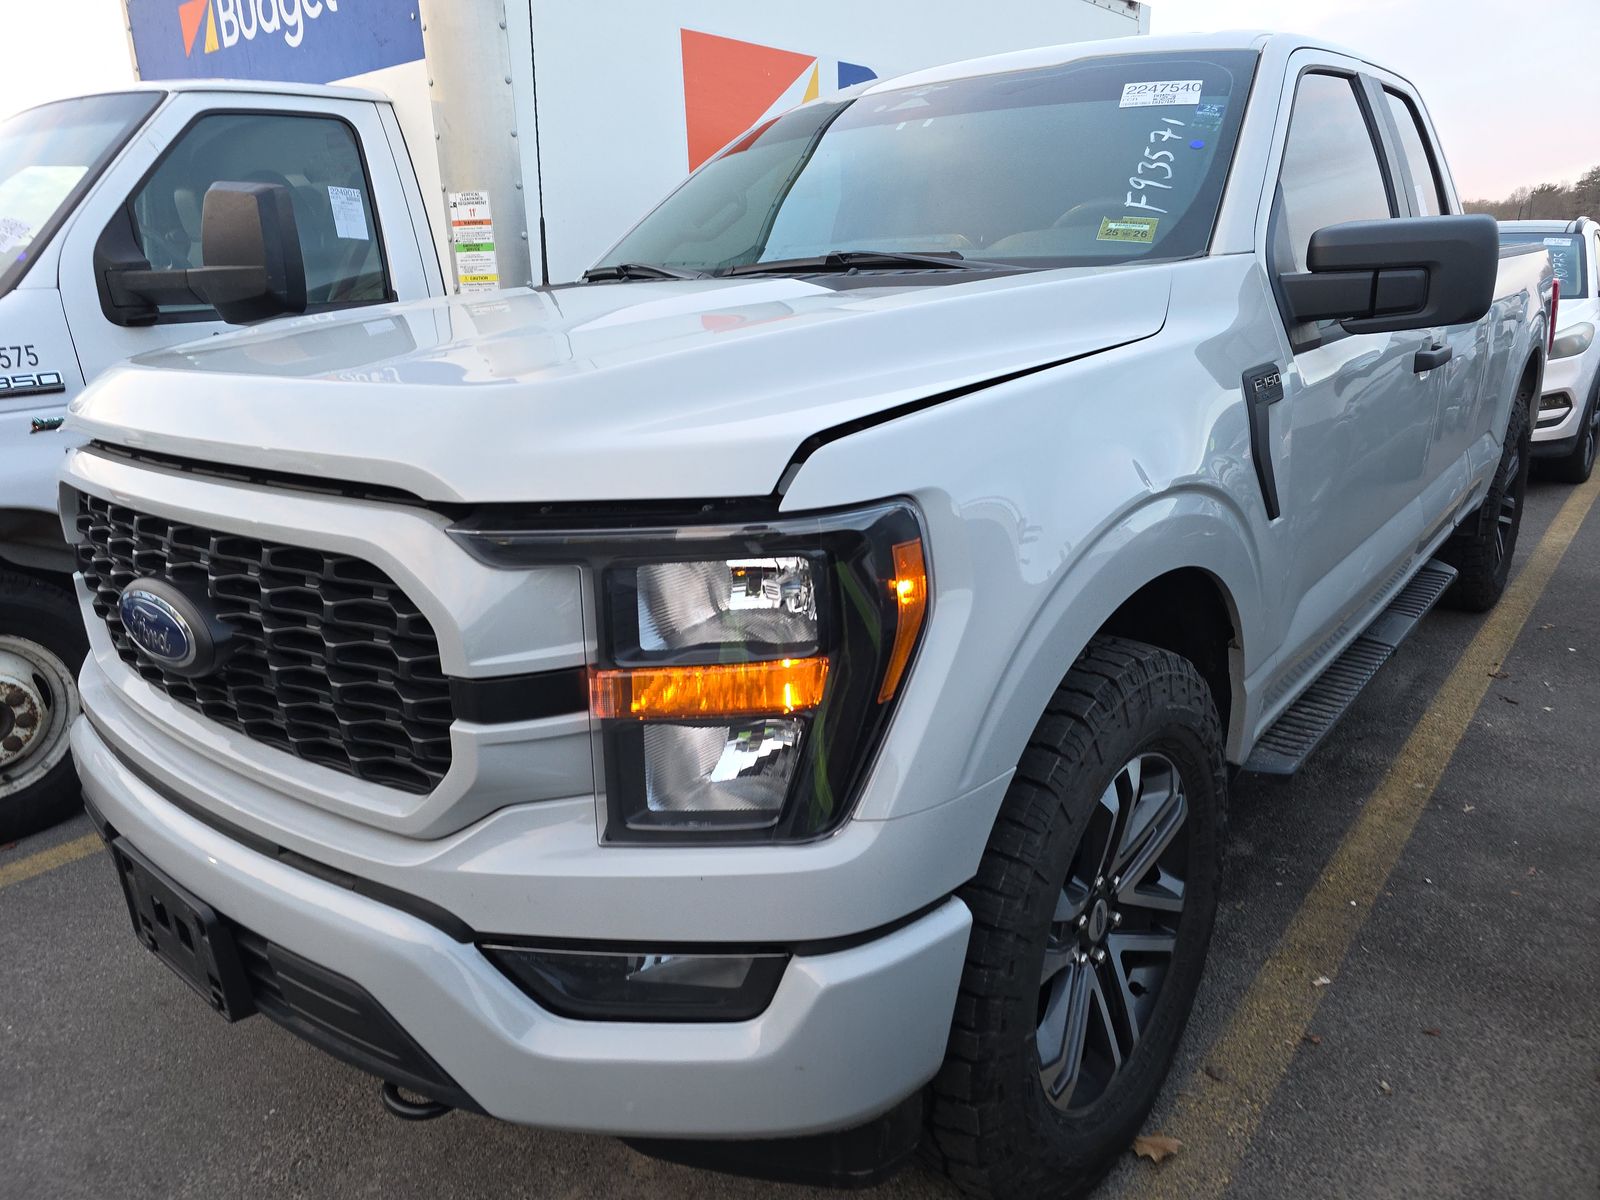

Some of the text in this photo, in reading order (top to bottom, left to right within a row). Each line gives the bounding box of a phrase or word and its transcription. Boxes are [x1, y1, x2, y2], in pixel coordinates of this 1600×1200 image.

[217, 0, 338, 48] Budg
[1126, 82, 1202, 95] 2247540
[1203, 105, 1218, 113] 25
[1124, 117, 1186, 214] F93571
[1105, 228, 1149, 238] 25 26
[0, 344, 39, 369] 575
[1254, 373, 1281, 392] F-150
[131, 605, 172, 653] Ford
